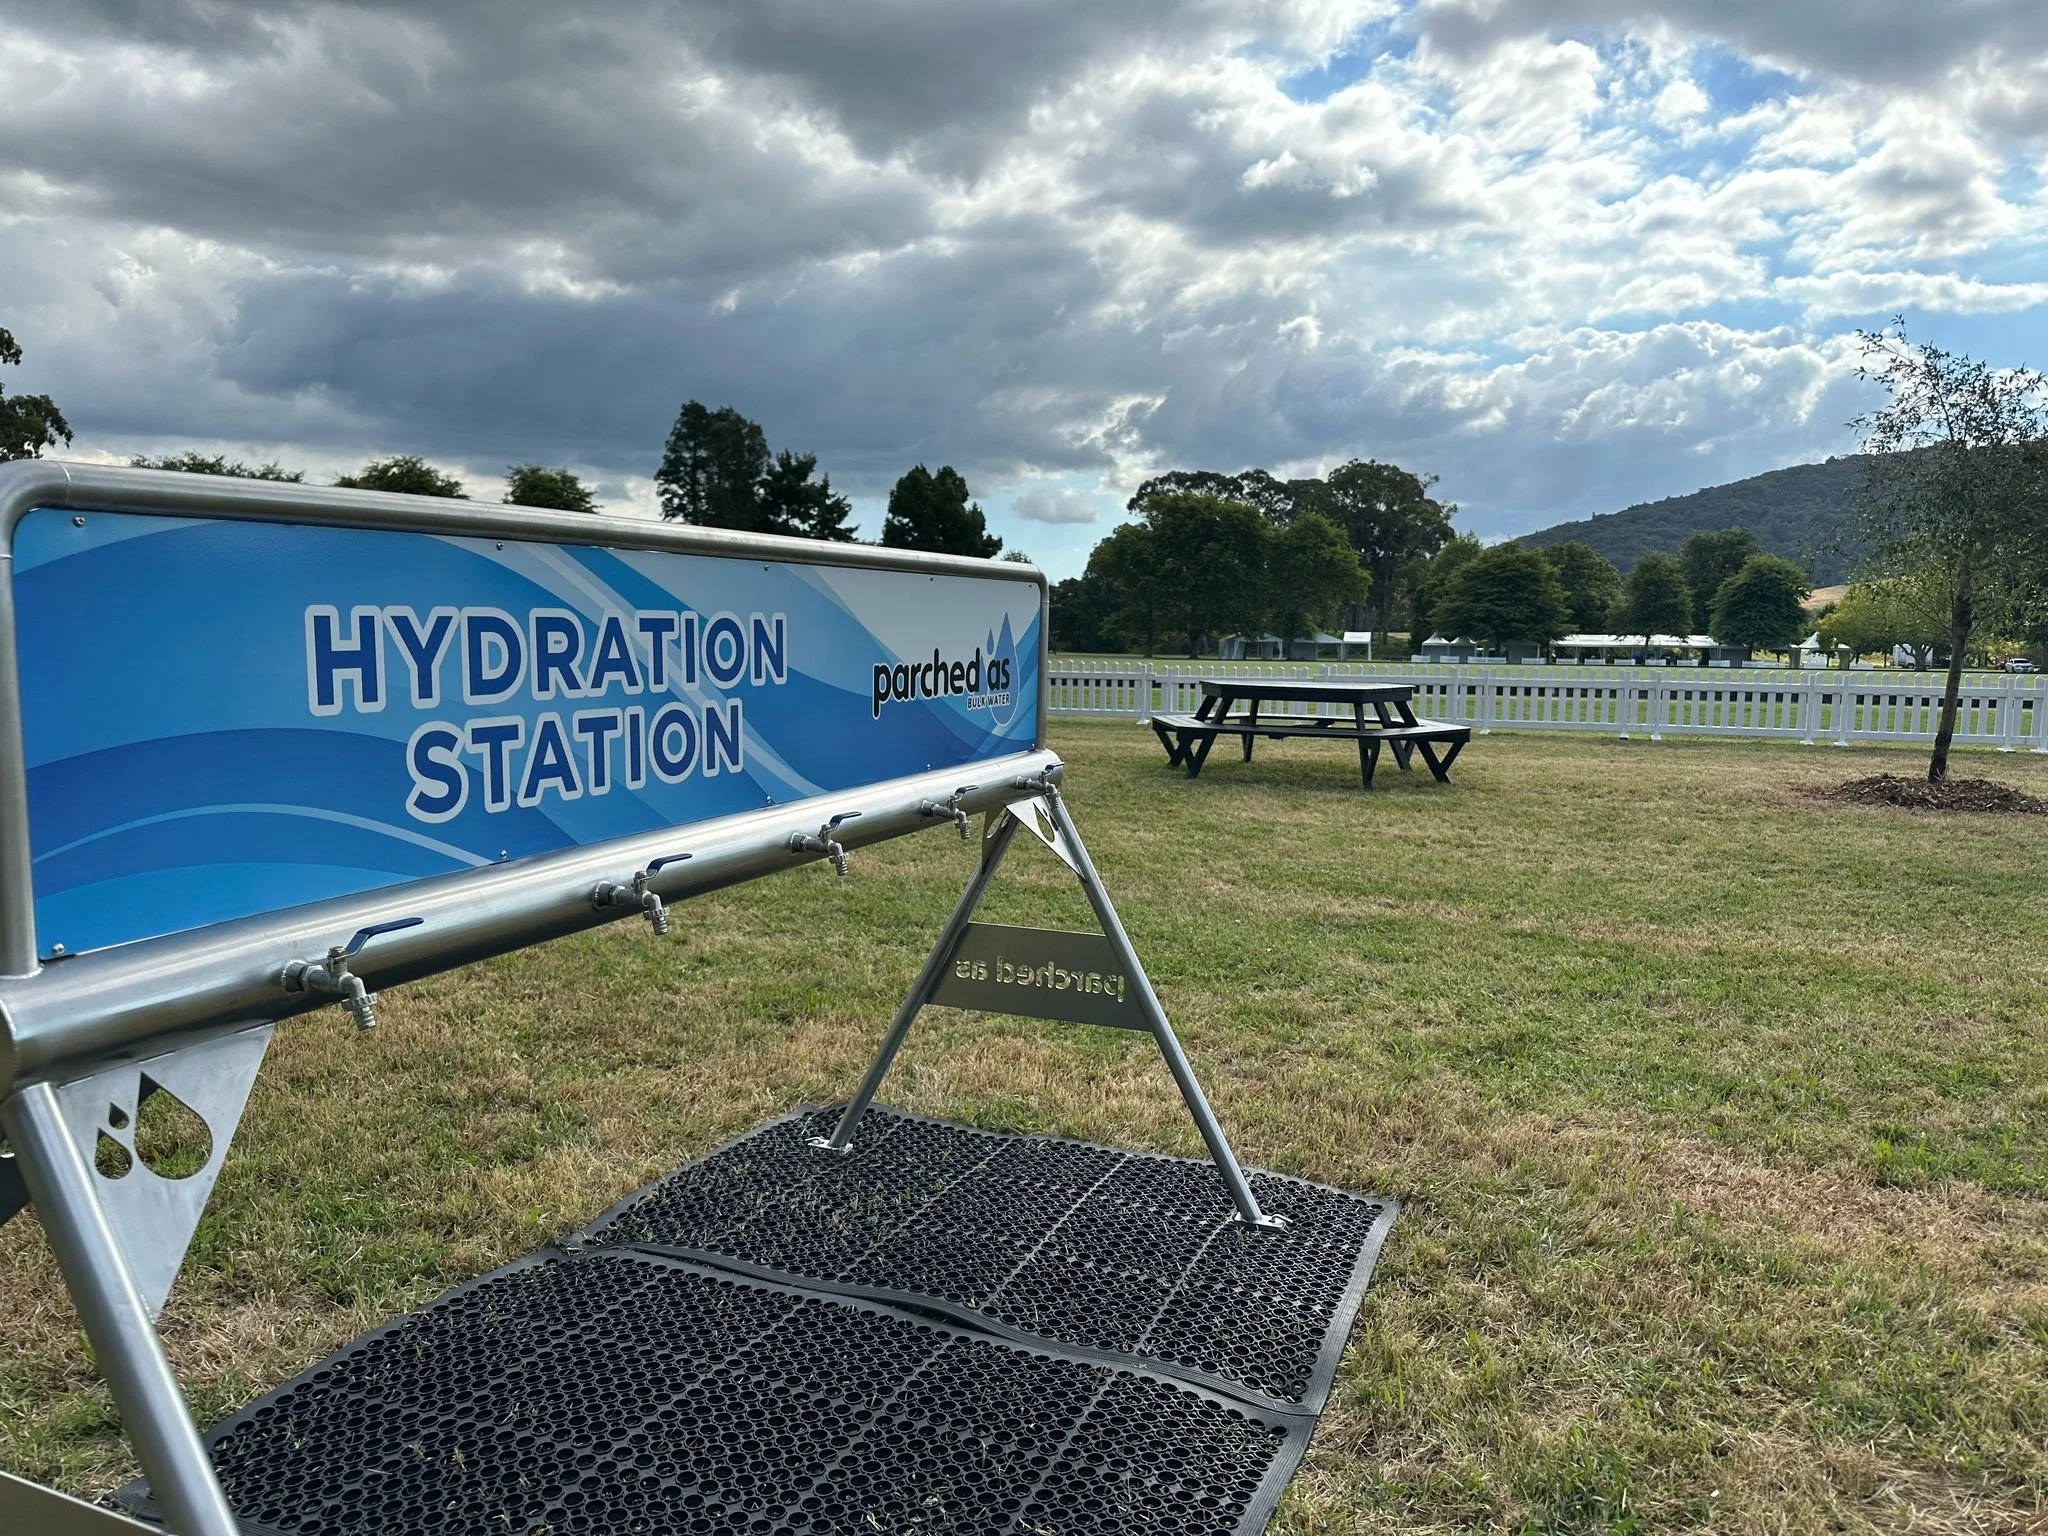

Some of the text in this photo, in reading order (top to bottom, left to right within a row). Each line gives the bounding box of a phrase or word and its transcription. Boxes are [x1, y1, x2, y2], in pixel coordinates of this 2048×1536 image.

[305, 604, 787, 716] HYDRATION
[872, 647, 1010, 719] parched as
[967, 692, 1011, 710] BULK WATER
[406, 697, 743, 823] STATION
